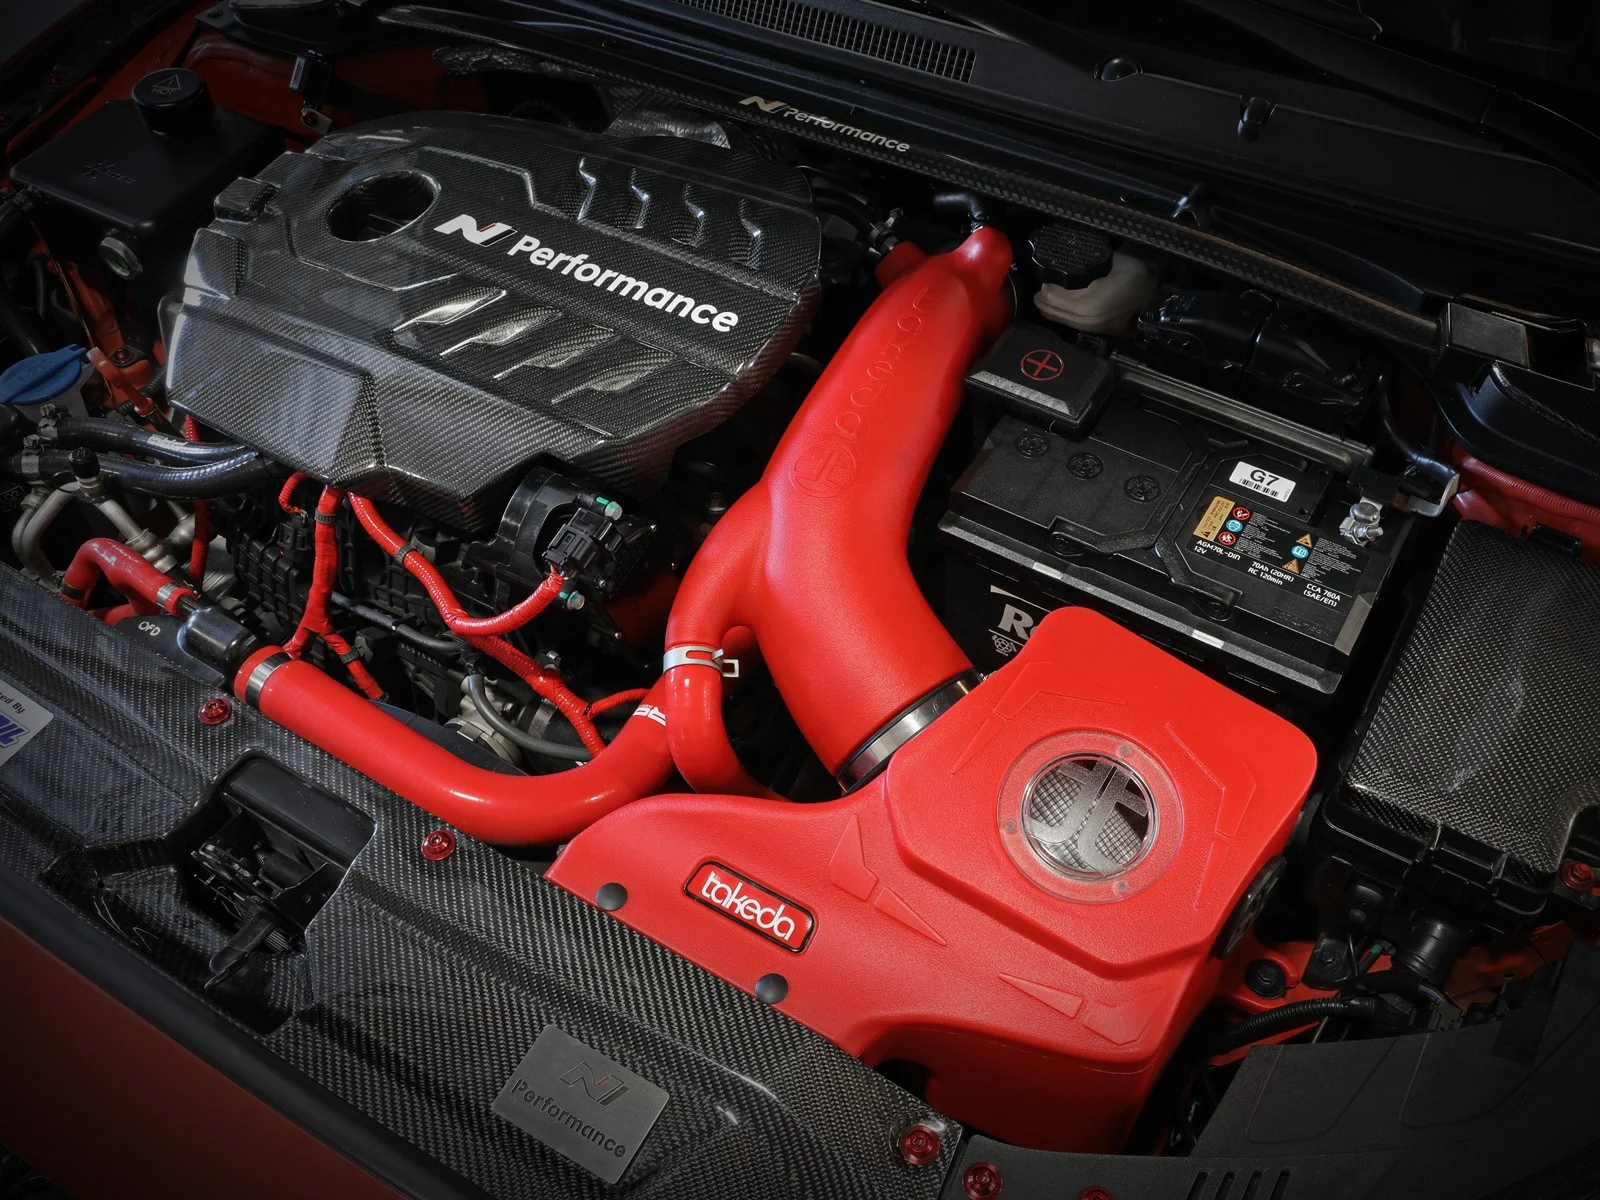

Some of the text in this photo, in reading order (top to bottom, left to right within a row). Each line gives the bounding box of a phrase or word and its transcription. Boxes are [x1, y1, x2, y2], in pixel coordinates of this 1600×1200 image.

[783, 107, 910, 152] Performance
[507, 235, 739, 332] Performance
[1250, 469, 1280, 487] G7
[1193, 545, 1207, 555] 12V
[1247, 567, 1283, 585] RC 120min
[1252, 561, 1295, 583] 70Ah (20HR)
[1306, 583, 1341, 601] CCA 760A
[12, 702, 26, 714] By
[701, 871, 796, 941] takeda
[511, 1078, 627, 1158] Performance
